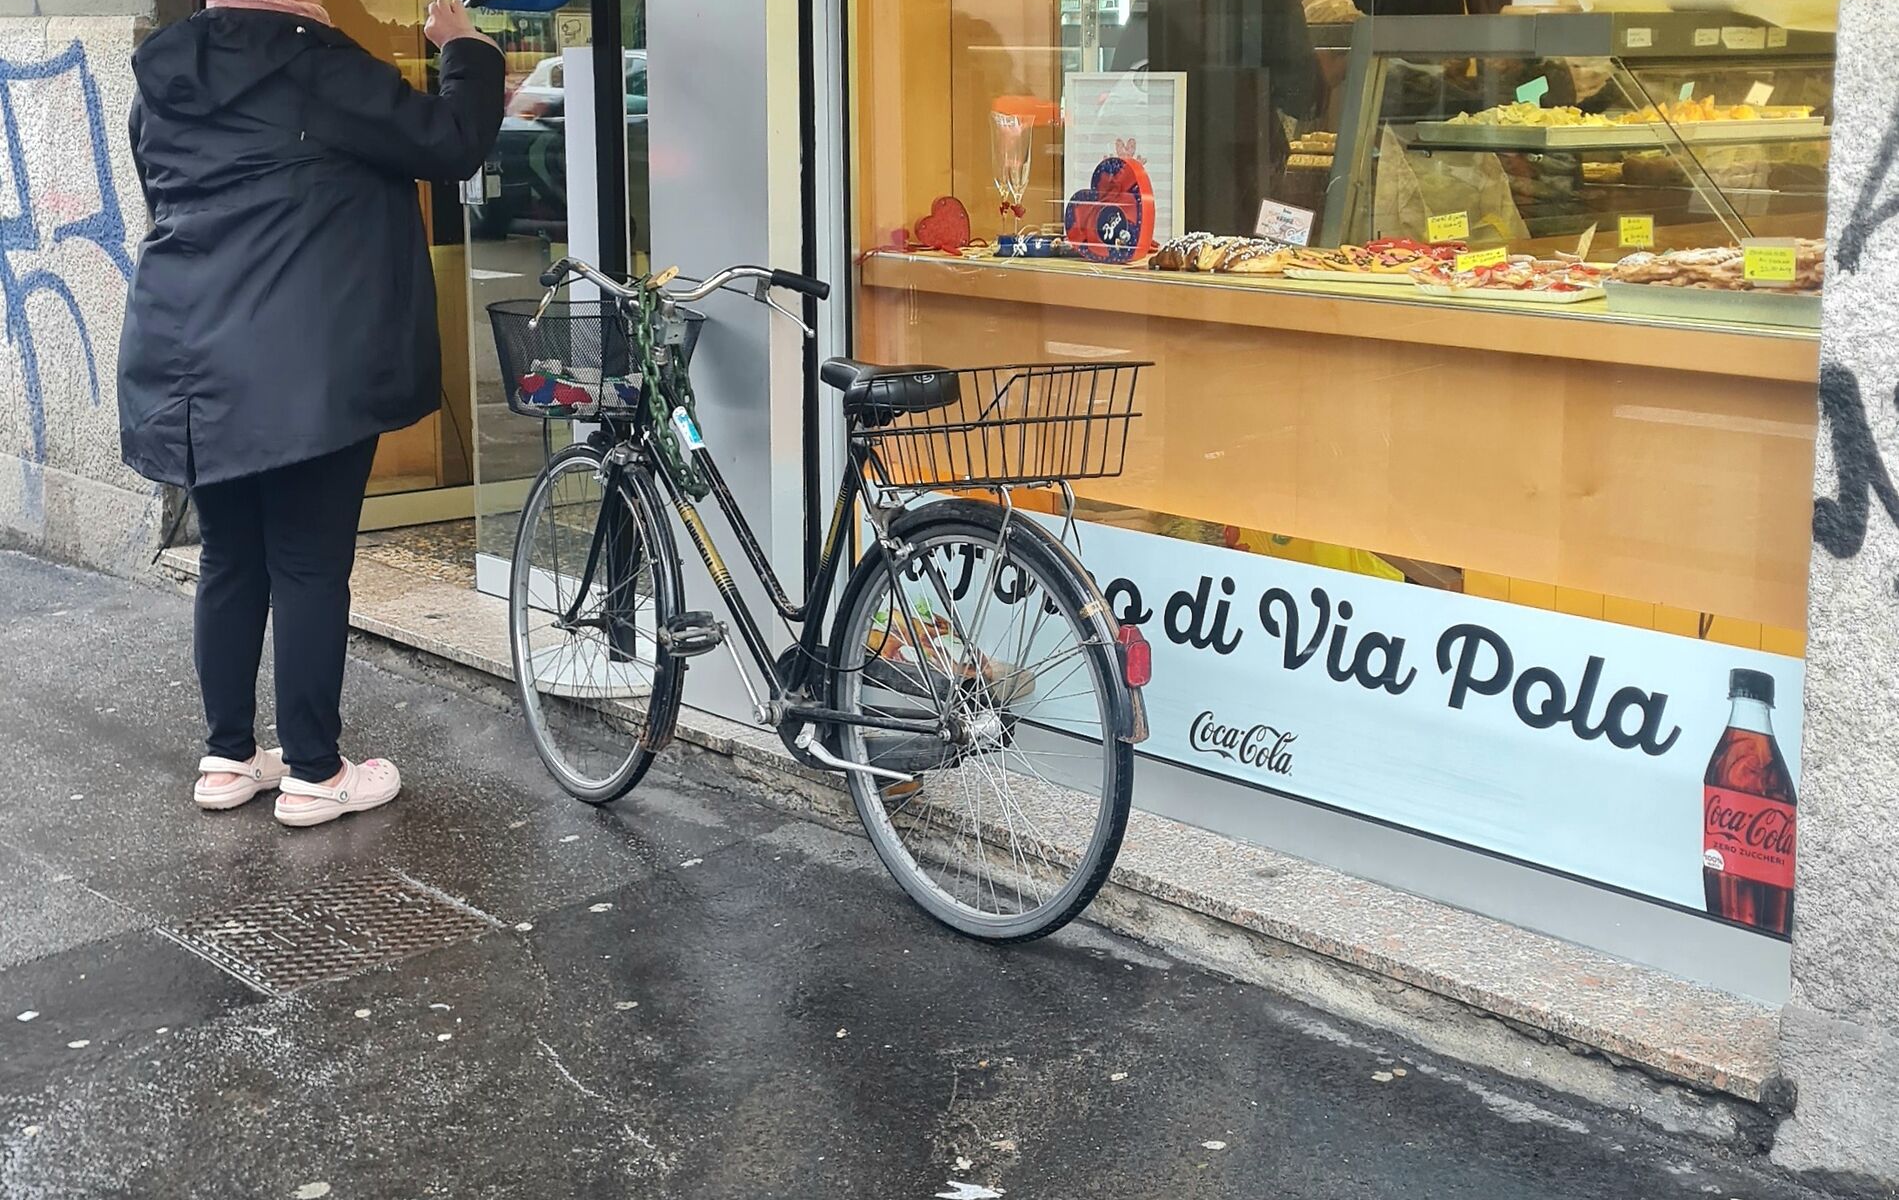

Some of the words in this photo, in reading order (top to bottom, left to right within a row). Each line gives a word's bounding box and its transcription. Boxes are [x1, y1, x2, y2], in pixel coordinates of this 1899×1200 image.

[1163, 575, 1244, 656] di
[1258, 586, 1418, 695] Via
[1435, 622, 1683, 757] Pola
[1713, 841, 1737, 854] ZERO
[1739, 848, 1785, 866] ZUCCHERI
